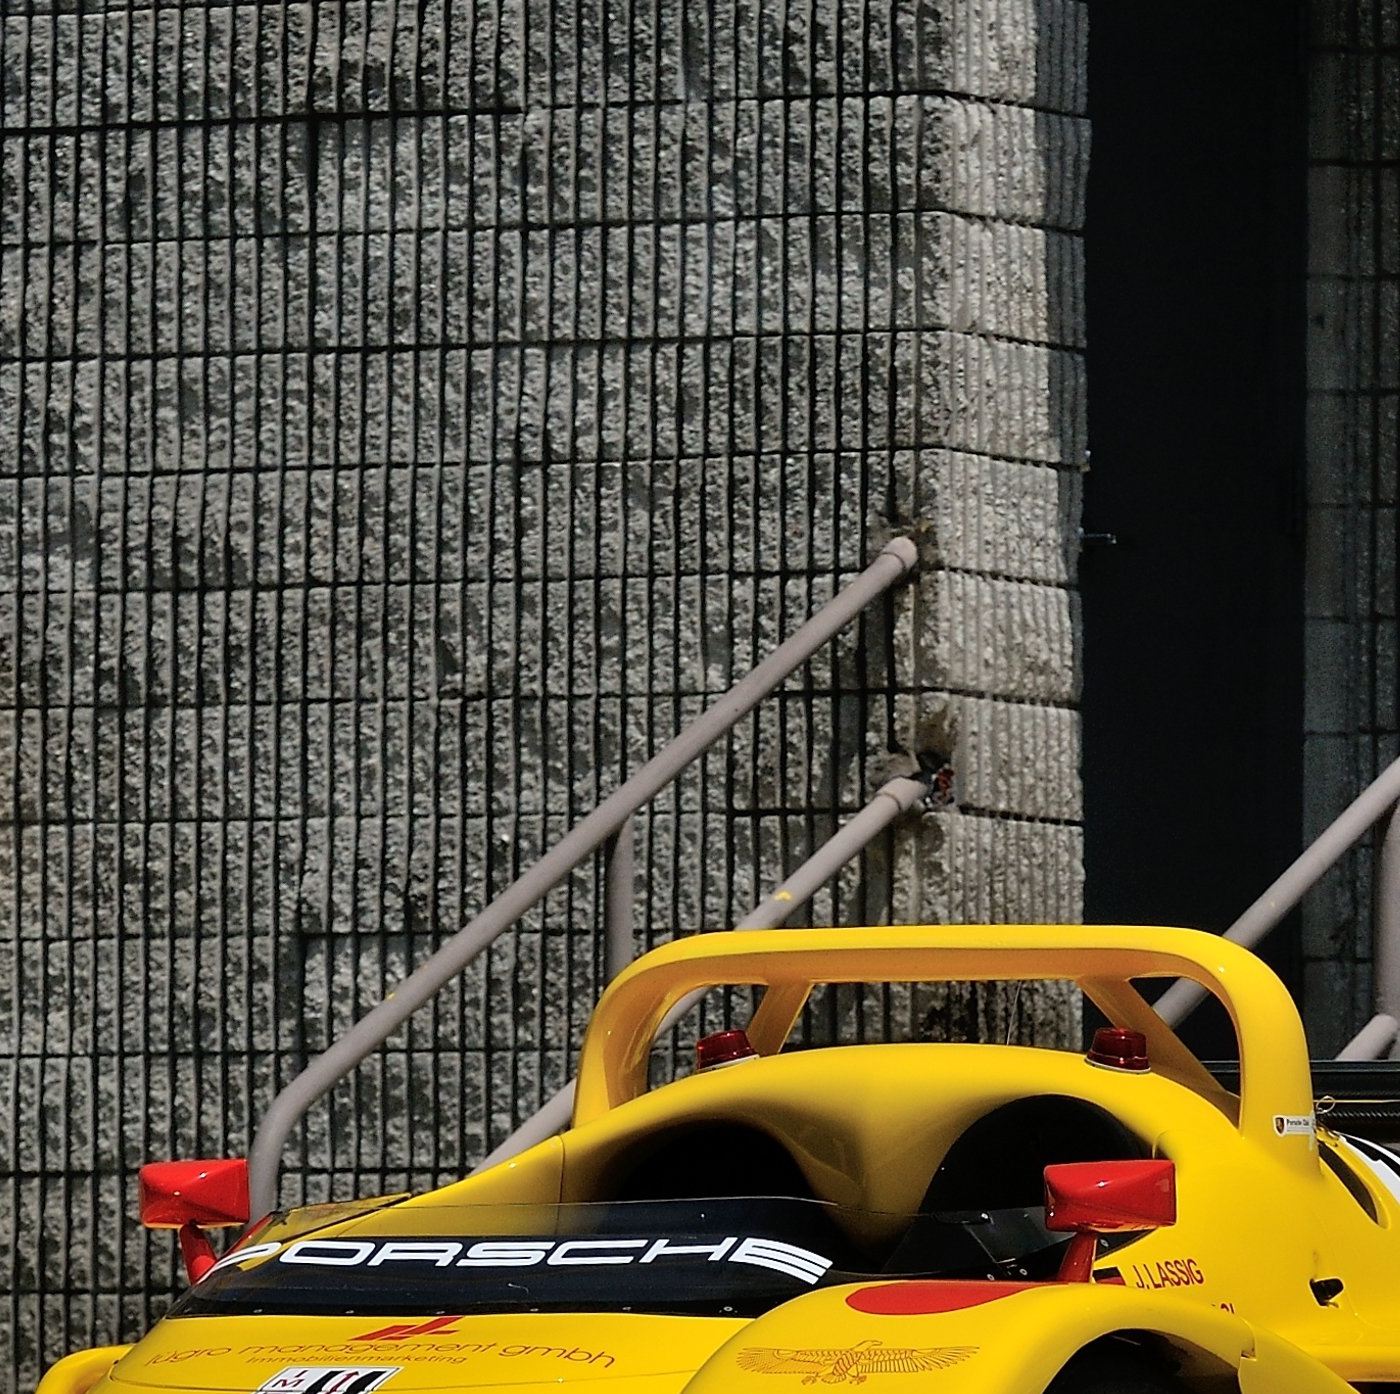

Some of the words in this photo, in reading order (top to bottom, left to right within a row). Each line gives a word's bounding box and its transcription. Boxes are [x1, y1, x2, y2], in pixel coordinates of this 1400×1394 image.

[197, 1236, 834, 1286] PORSCHE
[237, 1342, 497, 1356] management
[498, 1344, 616, 1369] gmbh
